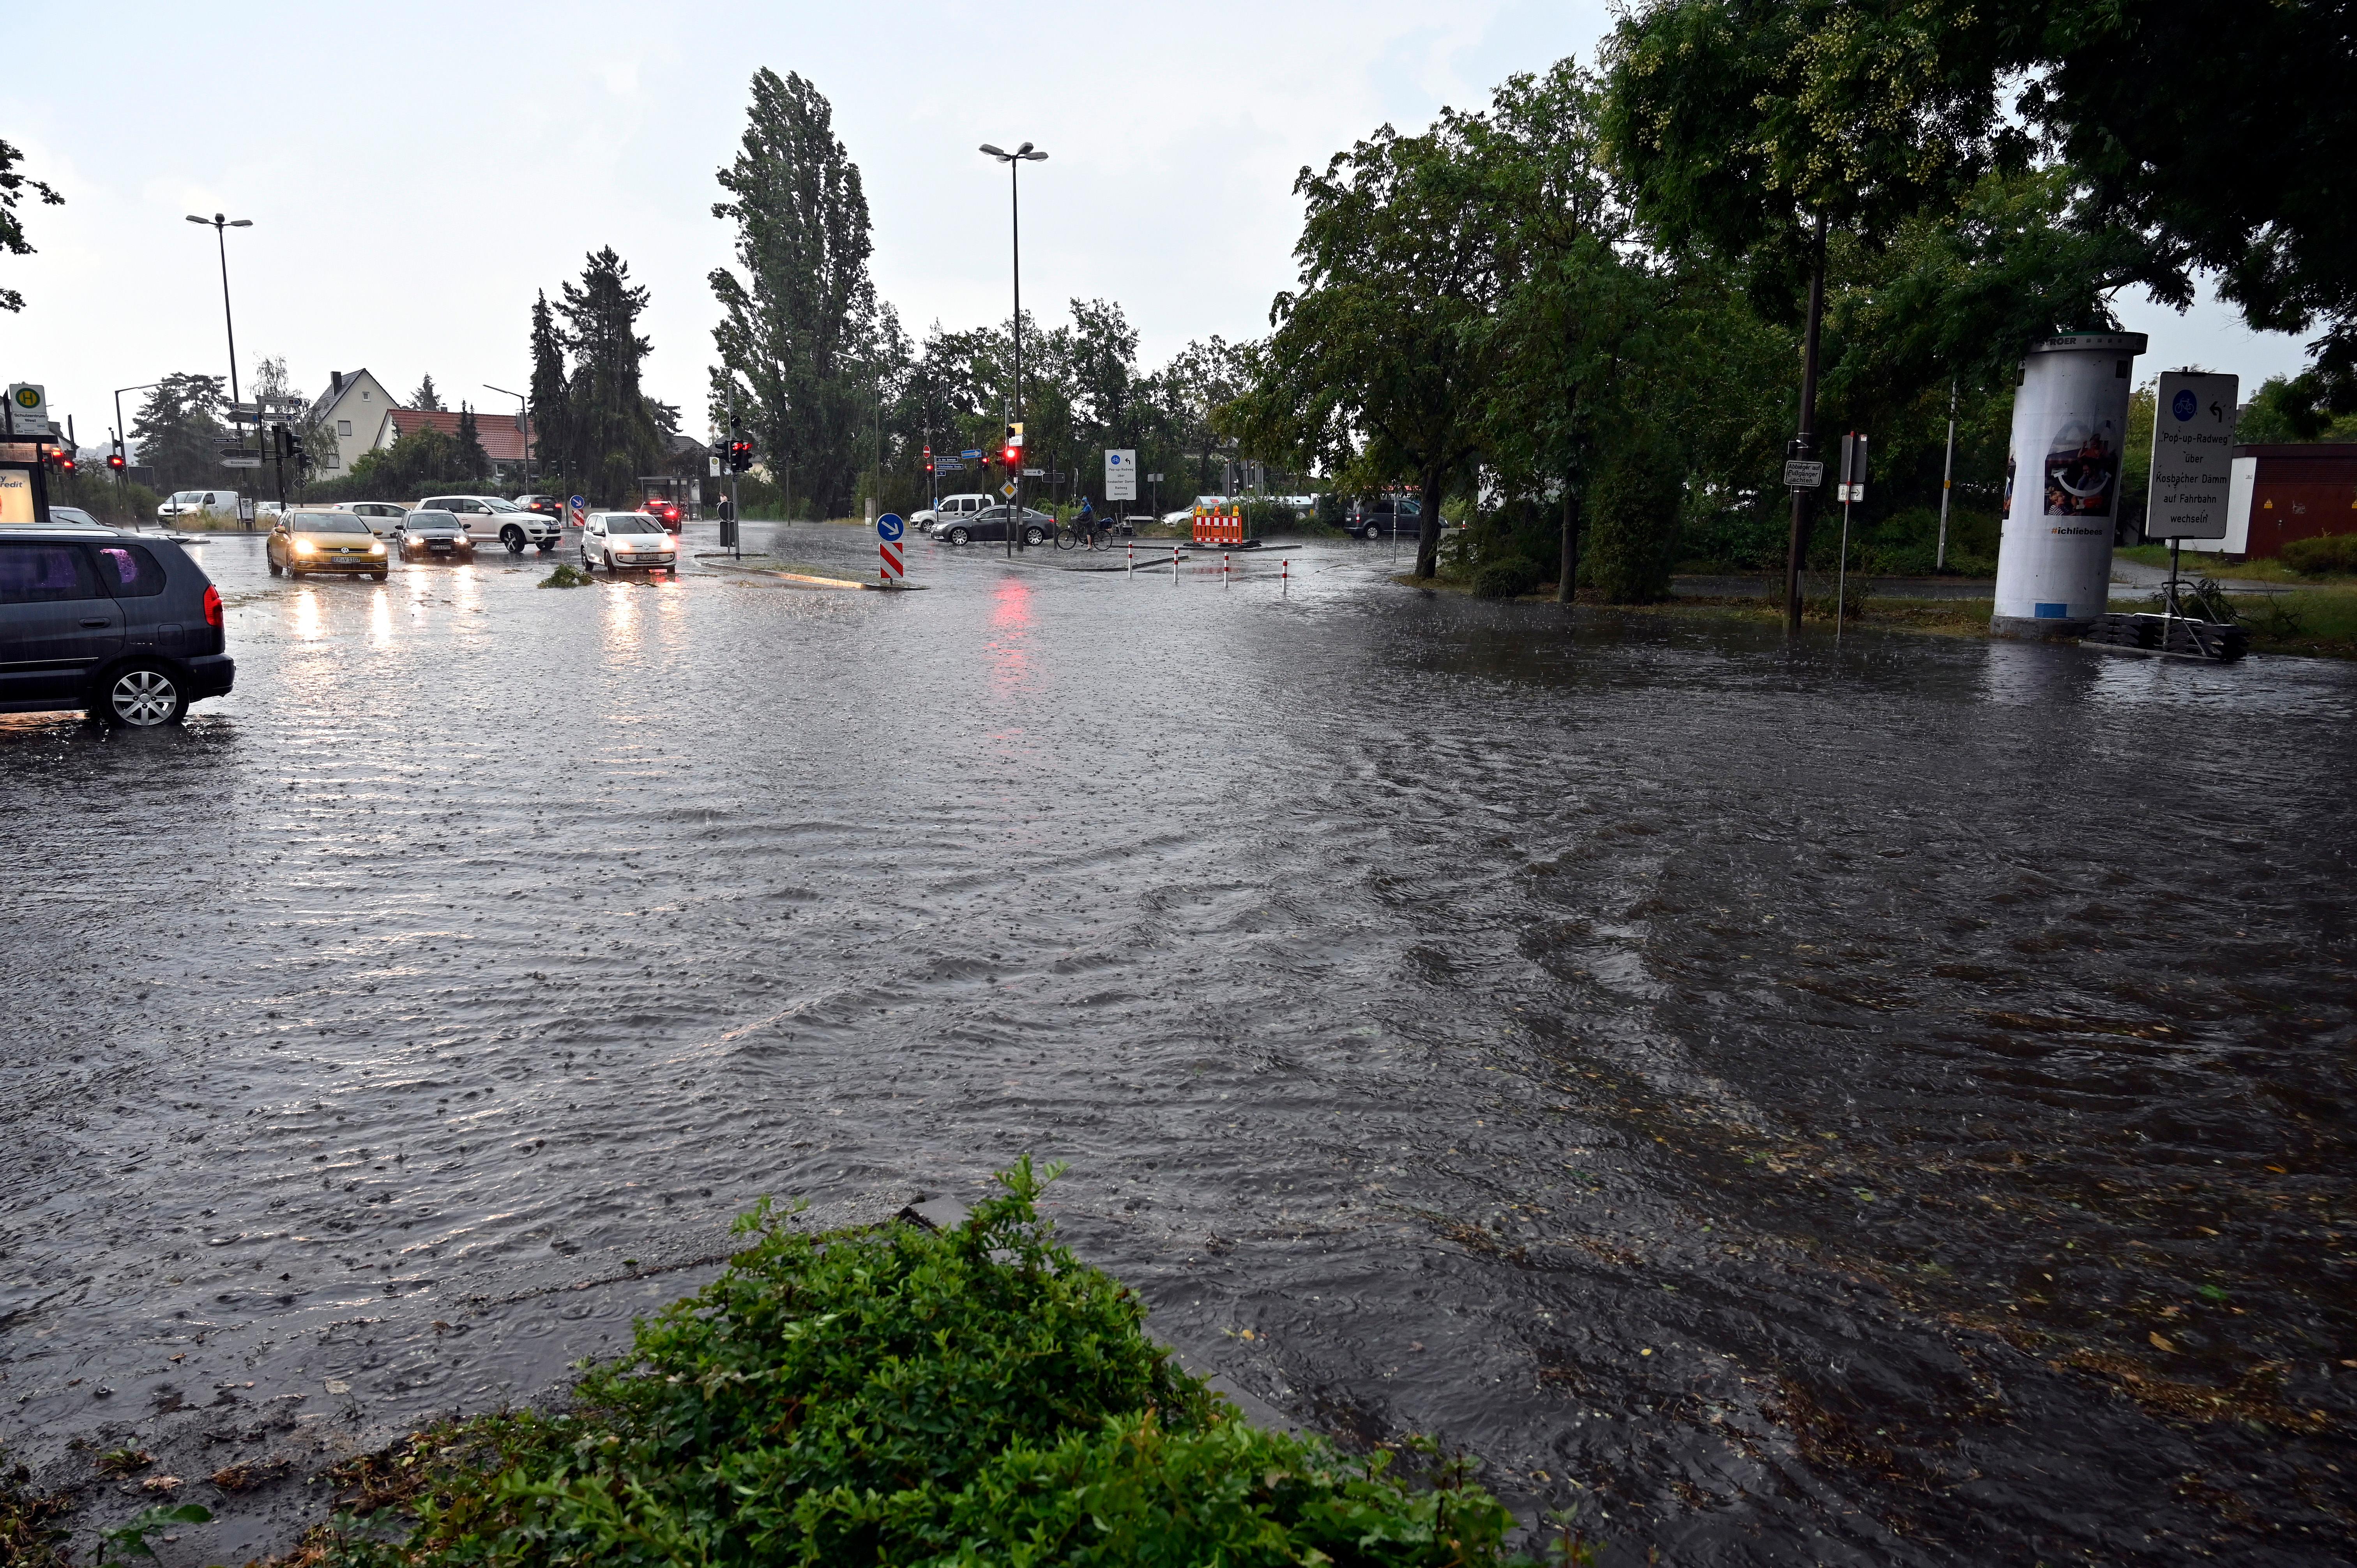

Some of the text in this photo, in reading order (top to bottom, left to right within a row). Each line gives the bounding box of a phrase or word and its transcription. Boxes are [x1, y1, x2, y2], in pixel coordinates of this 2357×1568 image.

[2186, 454, 2203, 463] über
[1788, 470, 1818, 478] Fußgänger
[2156, 473, 2227, 484] Kosbacher Damm
[2164, 494, 2216, 503] auf Fahrbahn
[2170, 514, 2208, 523] wechseln
[2051, 527, 2102, 535] #ichliebees
